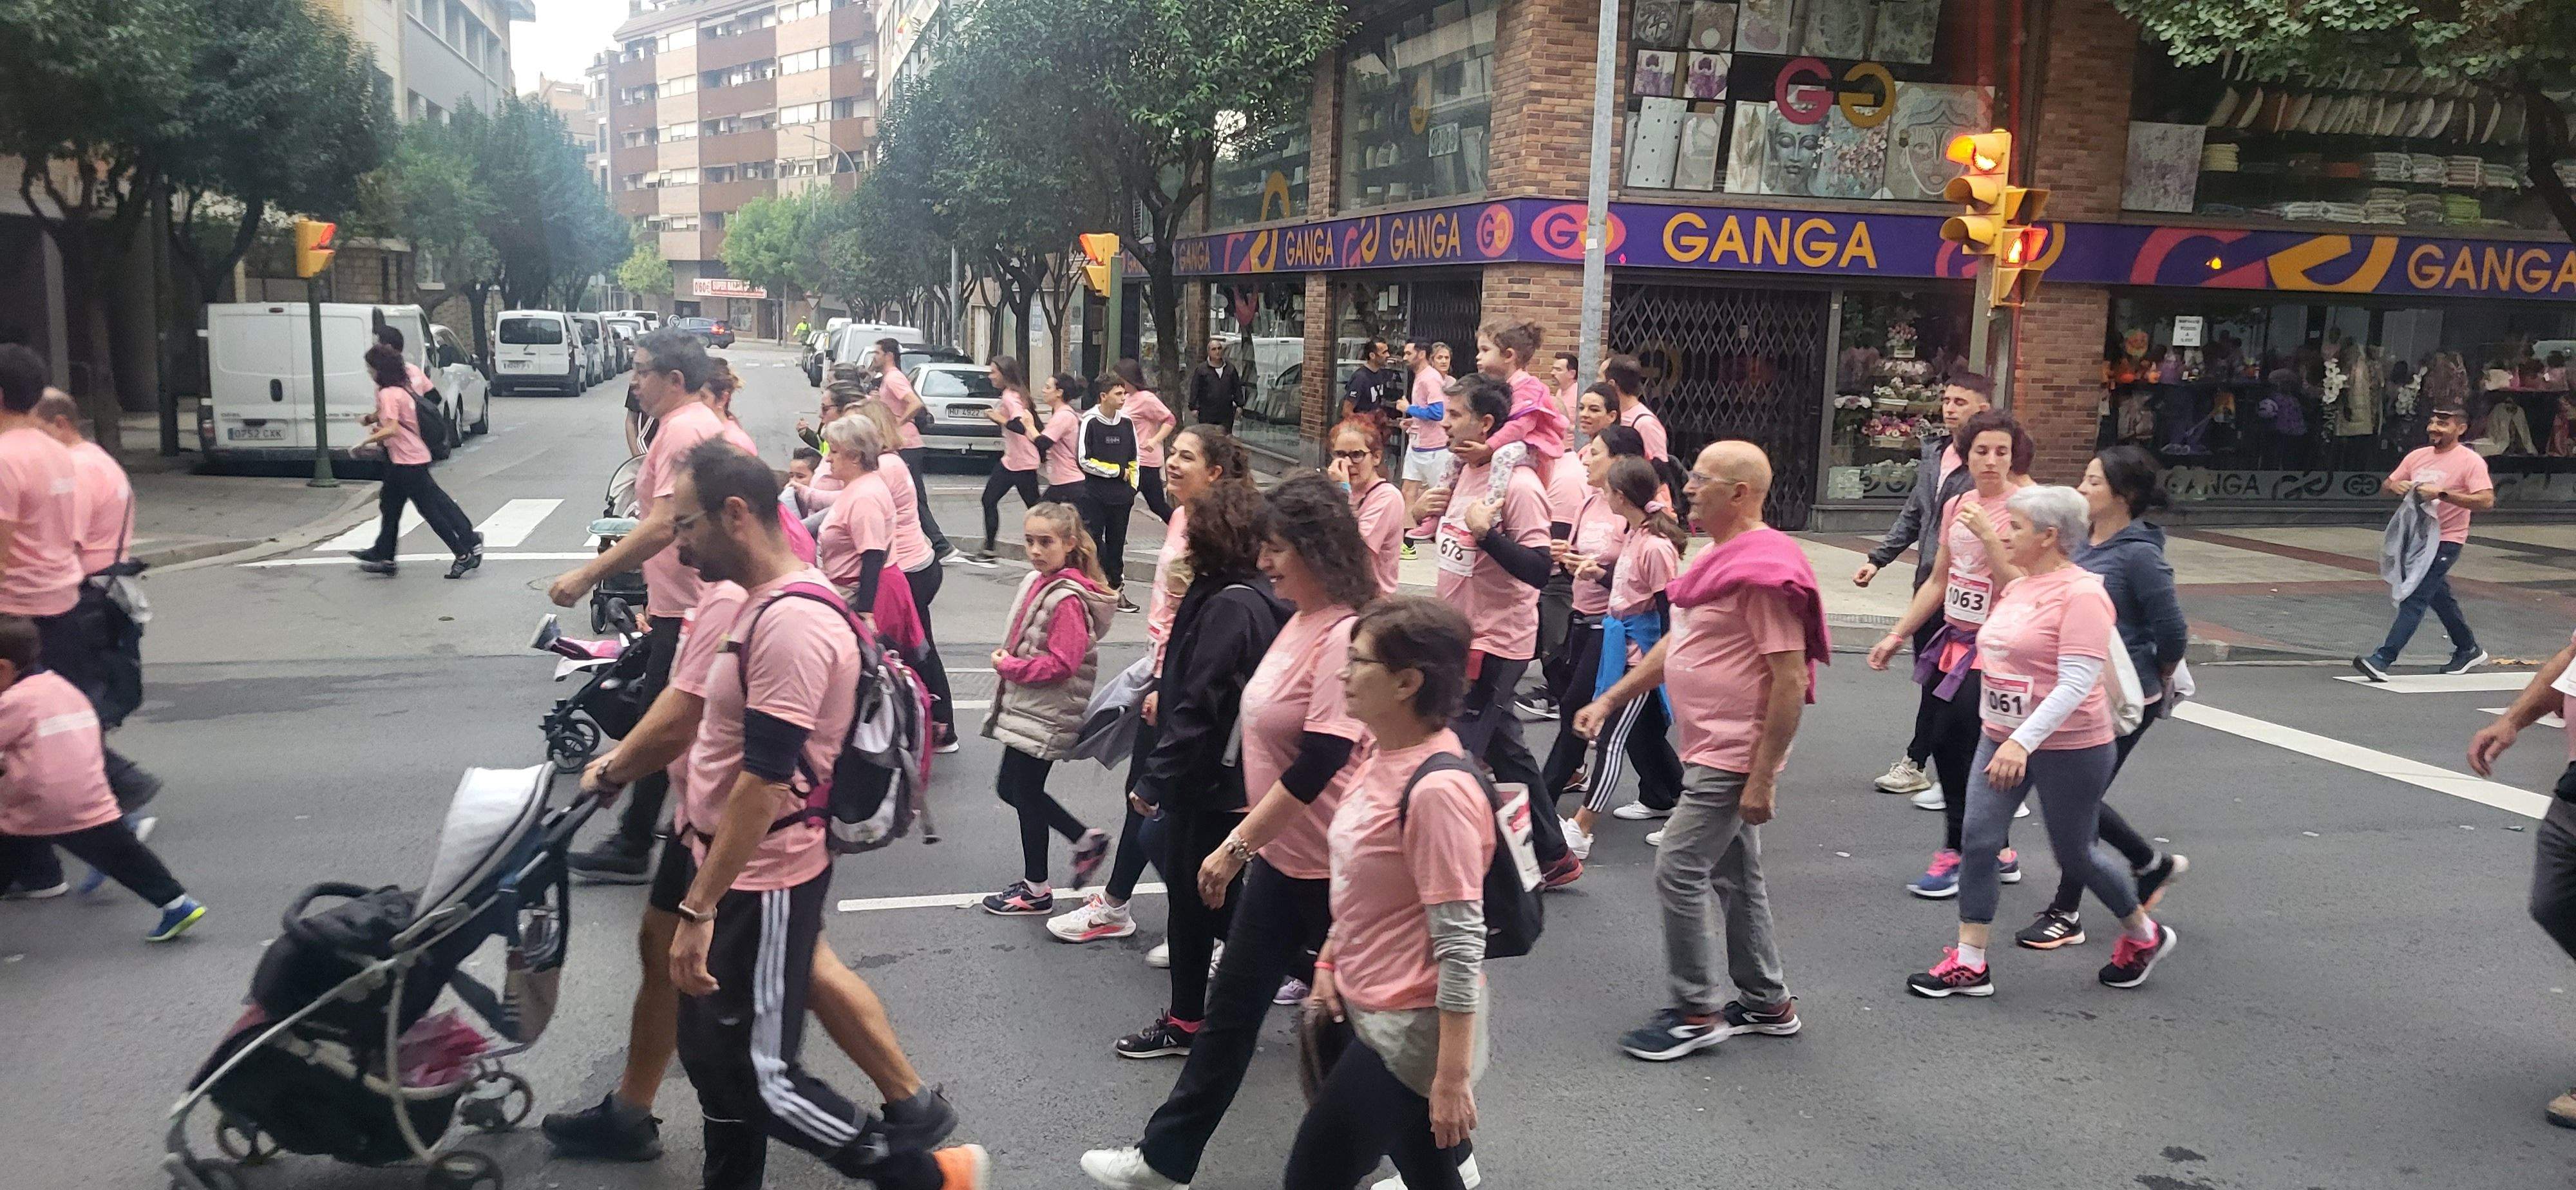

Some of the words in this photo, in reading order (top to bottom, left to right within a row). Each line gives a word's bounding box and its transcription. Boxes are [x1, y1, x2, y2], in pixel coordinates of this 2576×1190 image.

[1179, 241, 1211, 272] GANGA
[1285, 227, 1334, 267] GANGA
[1390, 212, 1461, 261] GANGA
[1663, 212, 1878, 269] GANGA
[2407, 244, 2576, 293] GANGA
[1947, 586, 1984, 611] 1063
